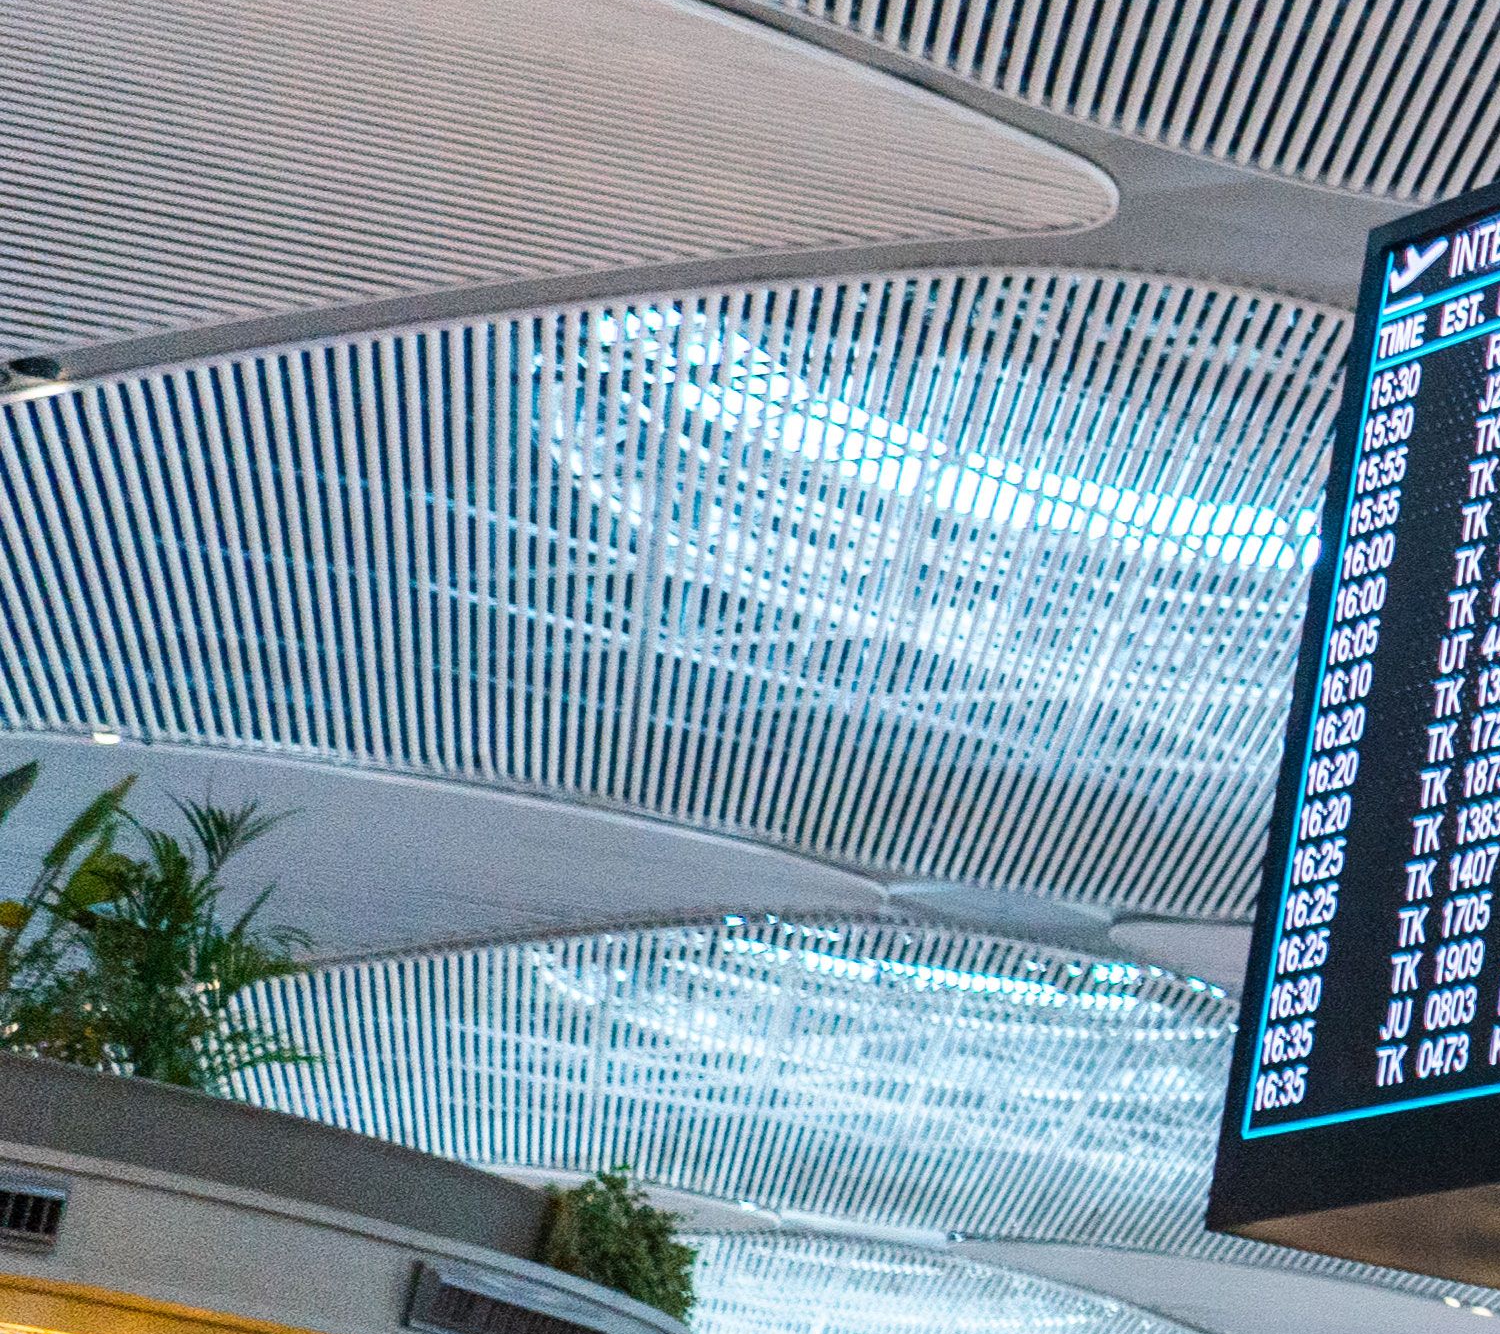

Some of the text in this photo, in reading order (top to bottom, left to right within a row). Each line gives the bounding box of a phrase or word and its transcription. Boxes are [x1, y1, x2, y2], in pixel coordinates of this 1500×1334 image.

[1377, 312, 1429, 361] TIME
[1437, 291, 1486, 338] EST.
[1362, 403, 1415, 453] 15:50
[1348, 487, 1402, 538] 15:55
[1467, 456, 1500, 500] TK
[1319, 660, 1374, 709] 16:10
[1437, 630, 1476, 675] UT
[1305, 748, 1360, 797] 16:20
[1425, 720, 1460, 764] TK
[1252, 1064, 1310, 1113] 16:35
[1374, 1043, 1409, 1088] TK
[1414, 1032, 1470, 1079] 0473
